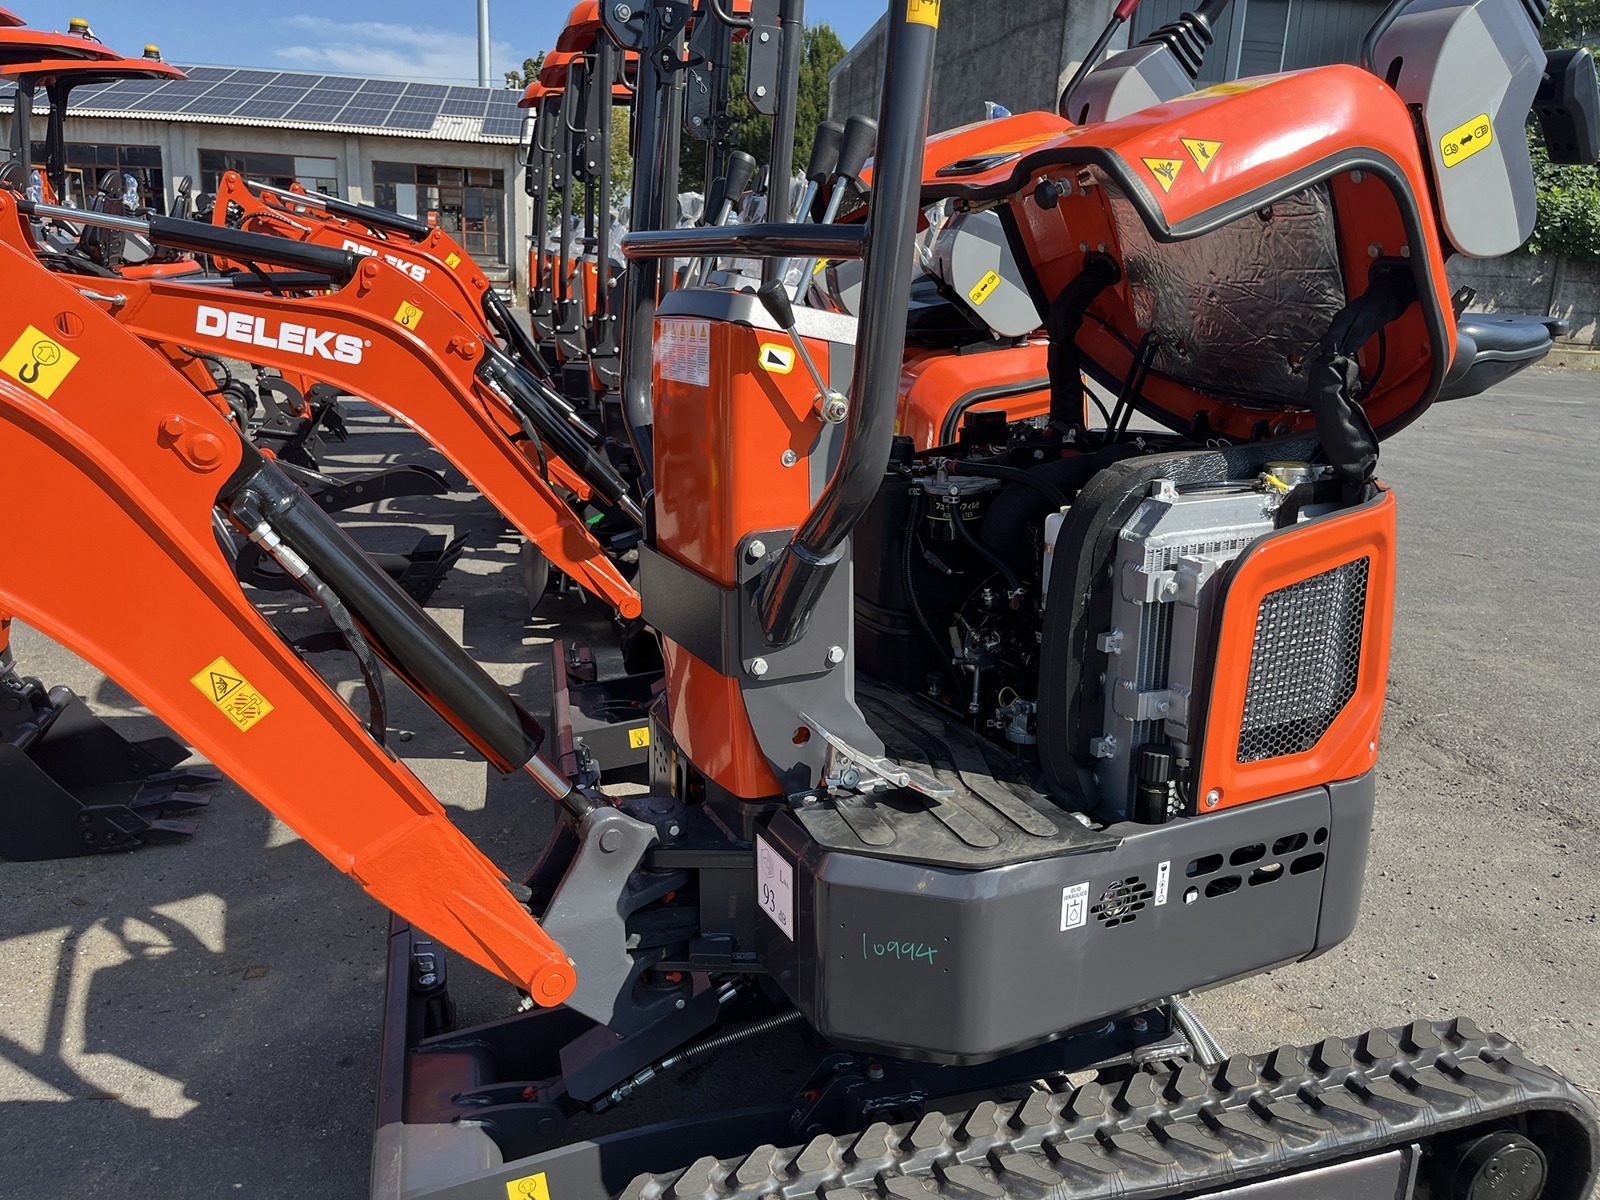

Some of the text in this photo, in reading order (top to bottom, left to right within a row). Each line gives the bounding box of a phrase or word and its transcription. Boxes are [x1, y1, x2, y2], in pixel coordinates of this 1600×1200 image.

[763, 883, 776, 913] 93
[1063, 890, 1088, 901] IDRAULICO
[1070, 886, 1082, 894] OLIO
[862, 932, 939, 965] 10994
